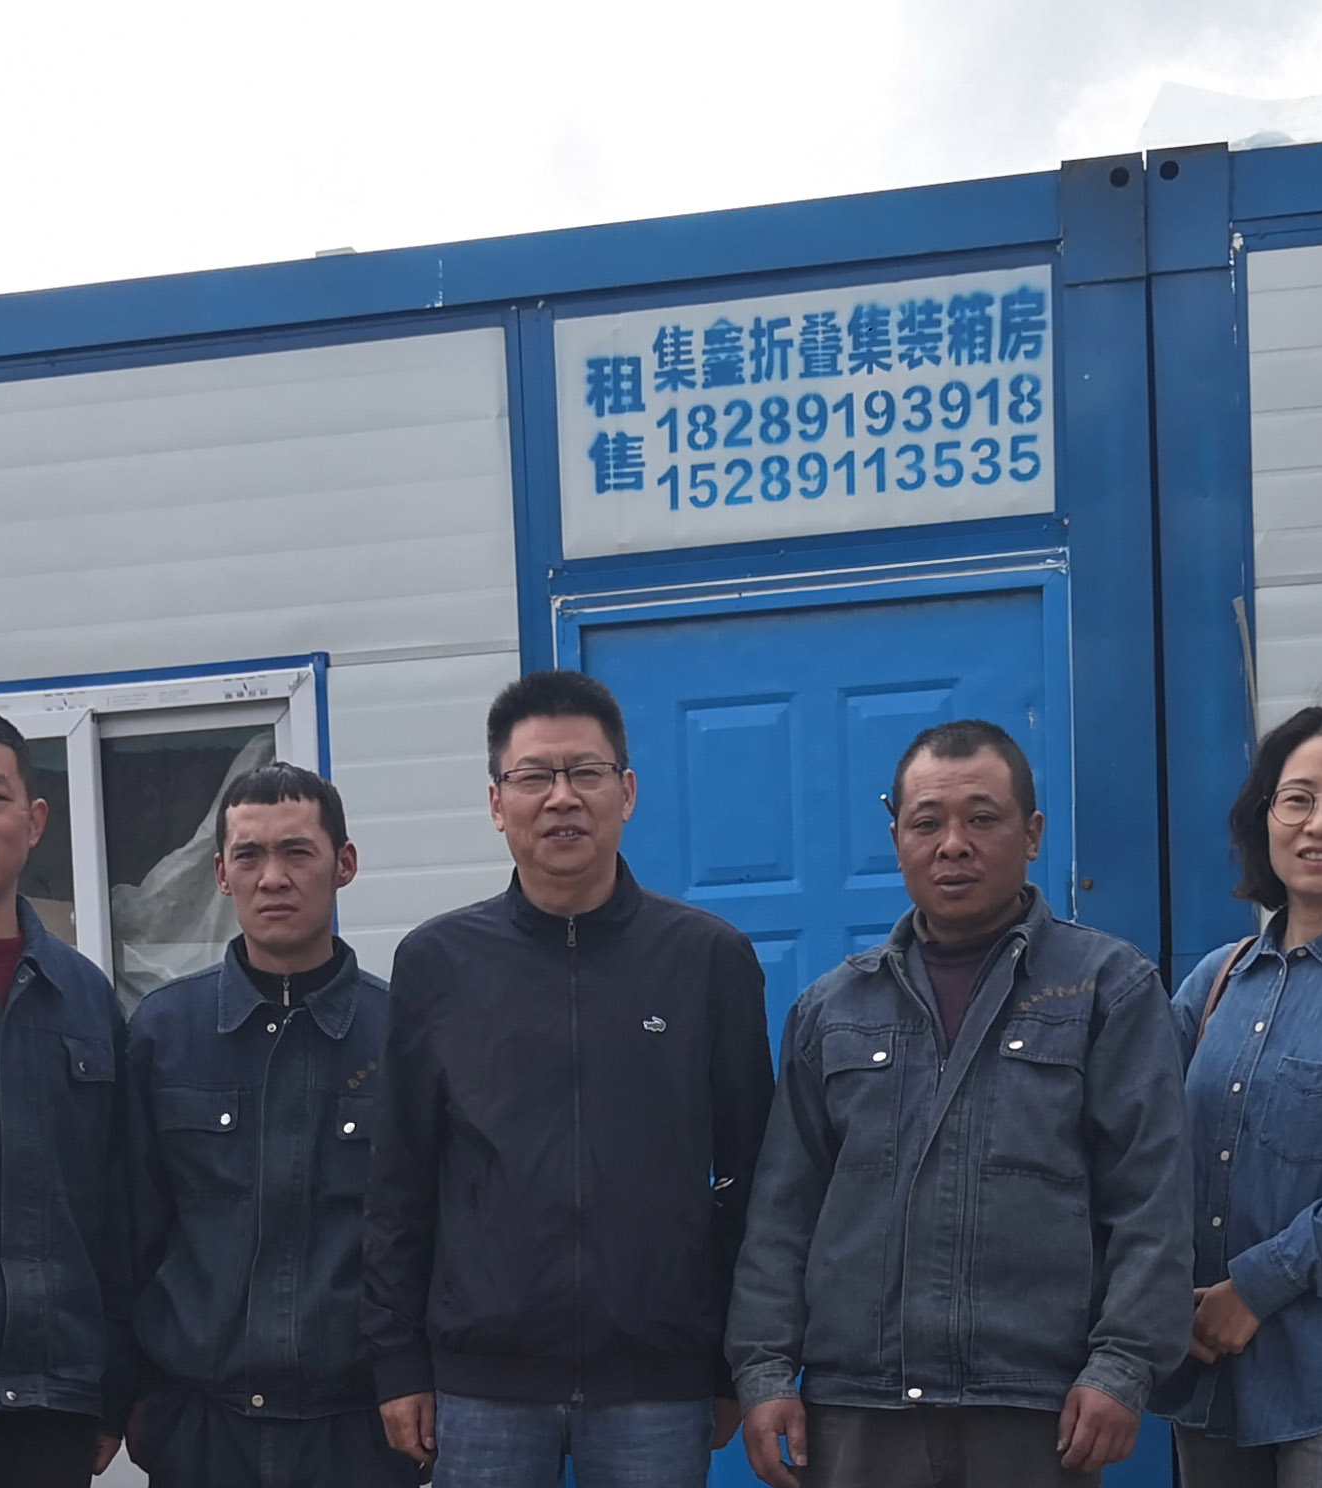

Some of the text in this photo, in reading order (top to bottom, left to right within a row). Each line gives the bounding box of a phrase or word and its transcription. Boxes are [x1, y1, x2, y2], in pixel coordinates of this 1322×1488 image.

[652, 285, 1048, 394] 集鑫折叠集装箱房
[655, 373, 1043, 454] 18289193918
[656, 433, 1042, 511] 15289113535
